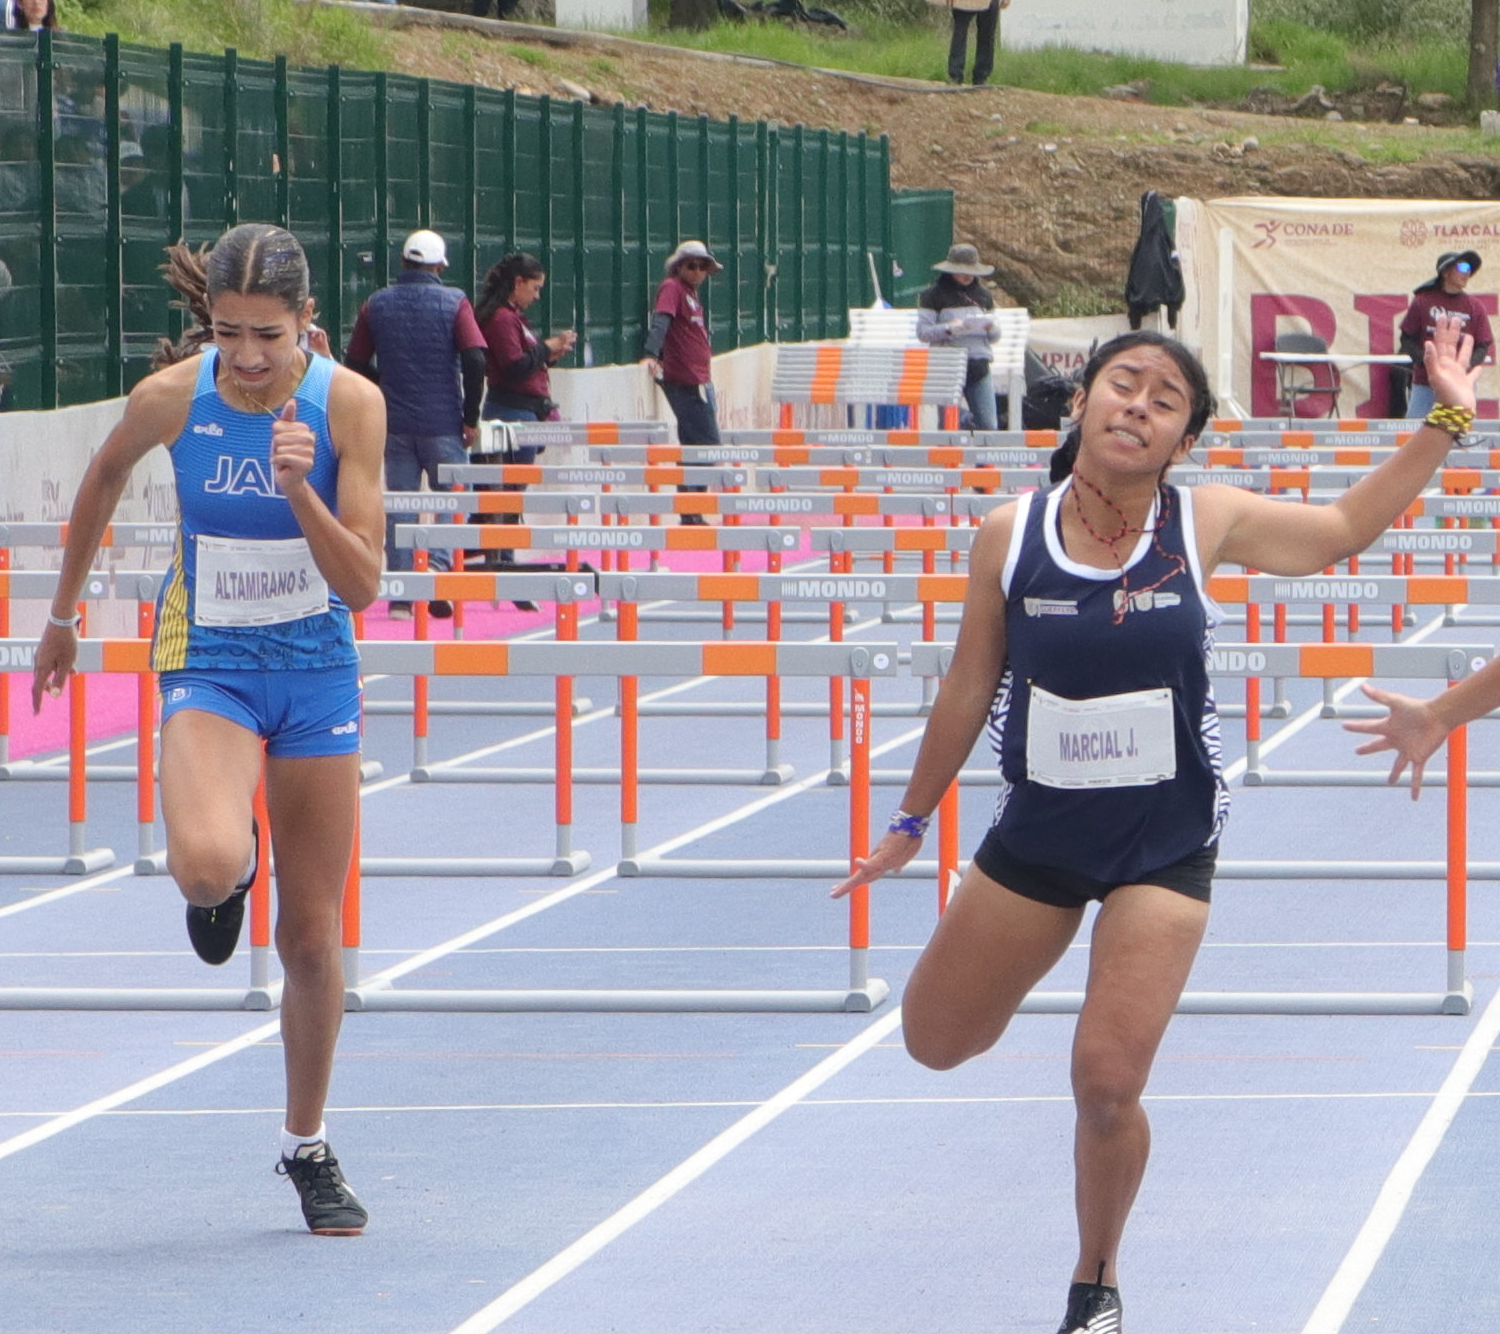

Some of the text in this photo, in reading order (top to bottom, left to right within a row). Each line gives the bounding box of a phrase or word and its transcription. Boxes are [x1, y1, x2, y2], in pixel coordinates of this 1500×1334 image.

[1284, 223, 1354, 236] CONADE
[826, 433, 874, 443] MONDO
[1334, 435, 1380, 446] MONDO
[707, 449, 759, 460] MONDO
[986, 452, 1038, 462] MONDO
[1268, 452, 1320, 464] MONDO
[570, 470, 626, 482] MONDO
[887, 473, 944, 484] MONDO
[1197, 474, 1254, 485] MONDO
[393, 497, 458, 511] MONDO
[748, 499, 812, 512] MONDO
[568, 531, 643, 547] MONDO
[1397, 535, 1473, 550] MONDO
[215, 569, 309, 601] ALTAMIRANO S.
[798, 580, 887, 598] MONDO
[1292, 582, 1379, 599] MONDO
[1209, 651, 1266, 671] NDO
[1059, 728, 1139, 762] MARCIAL J.
